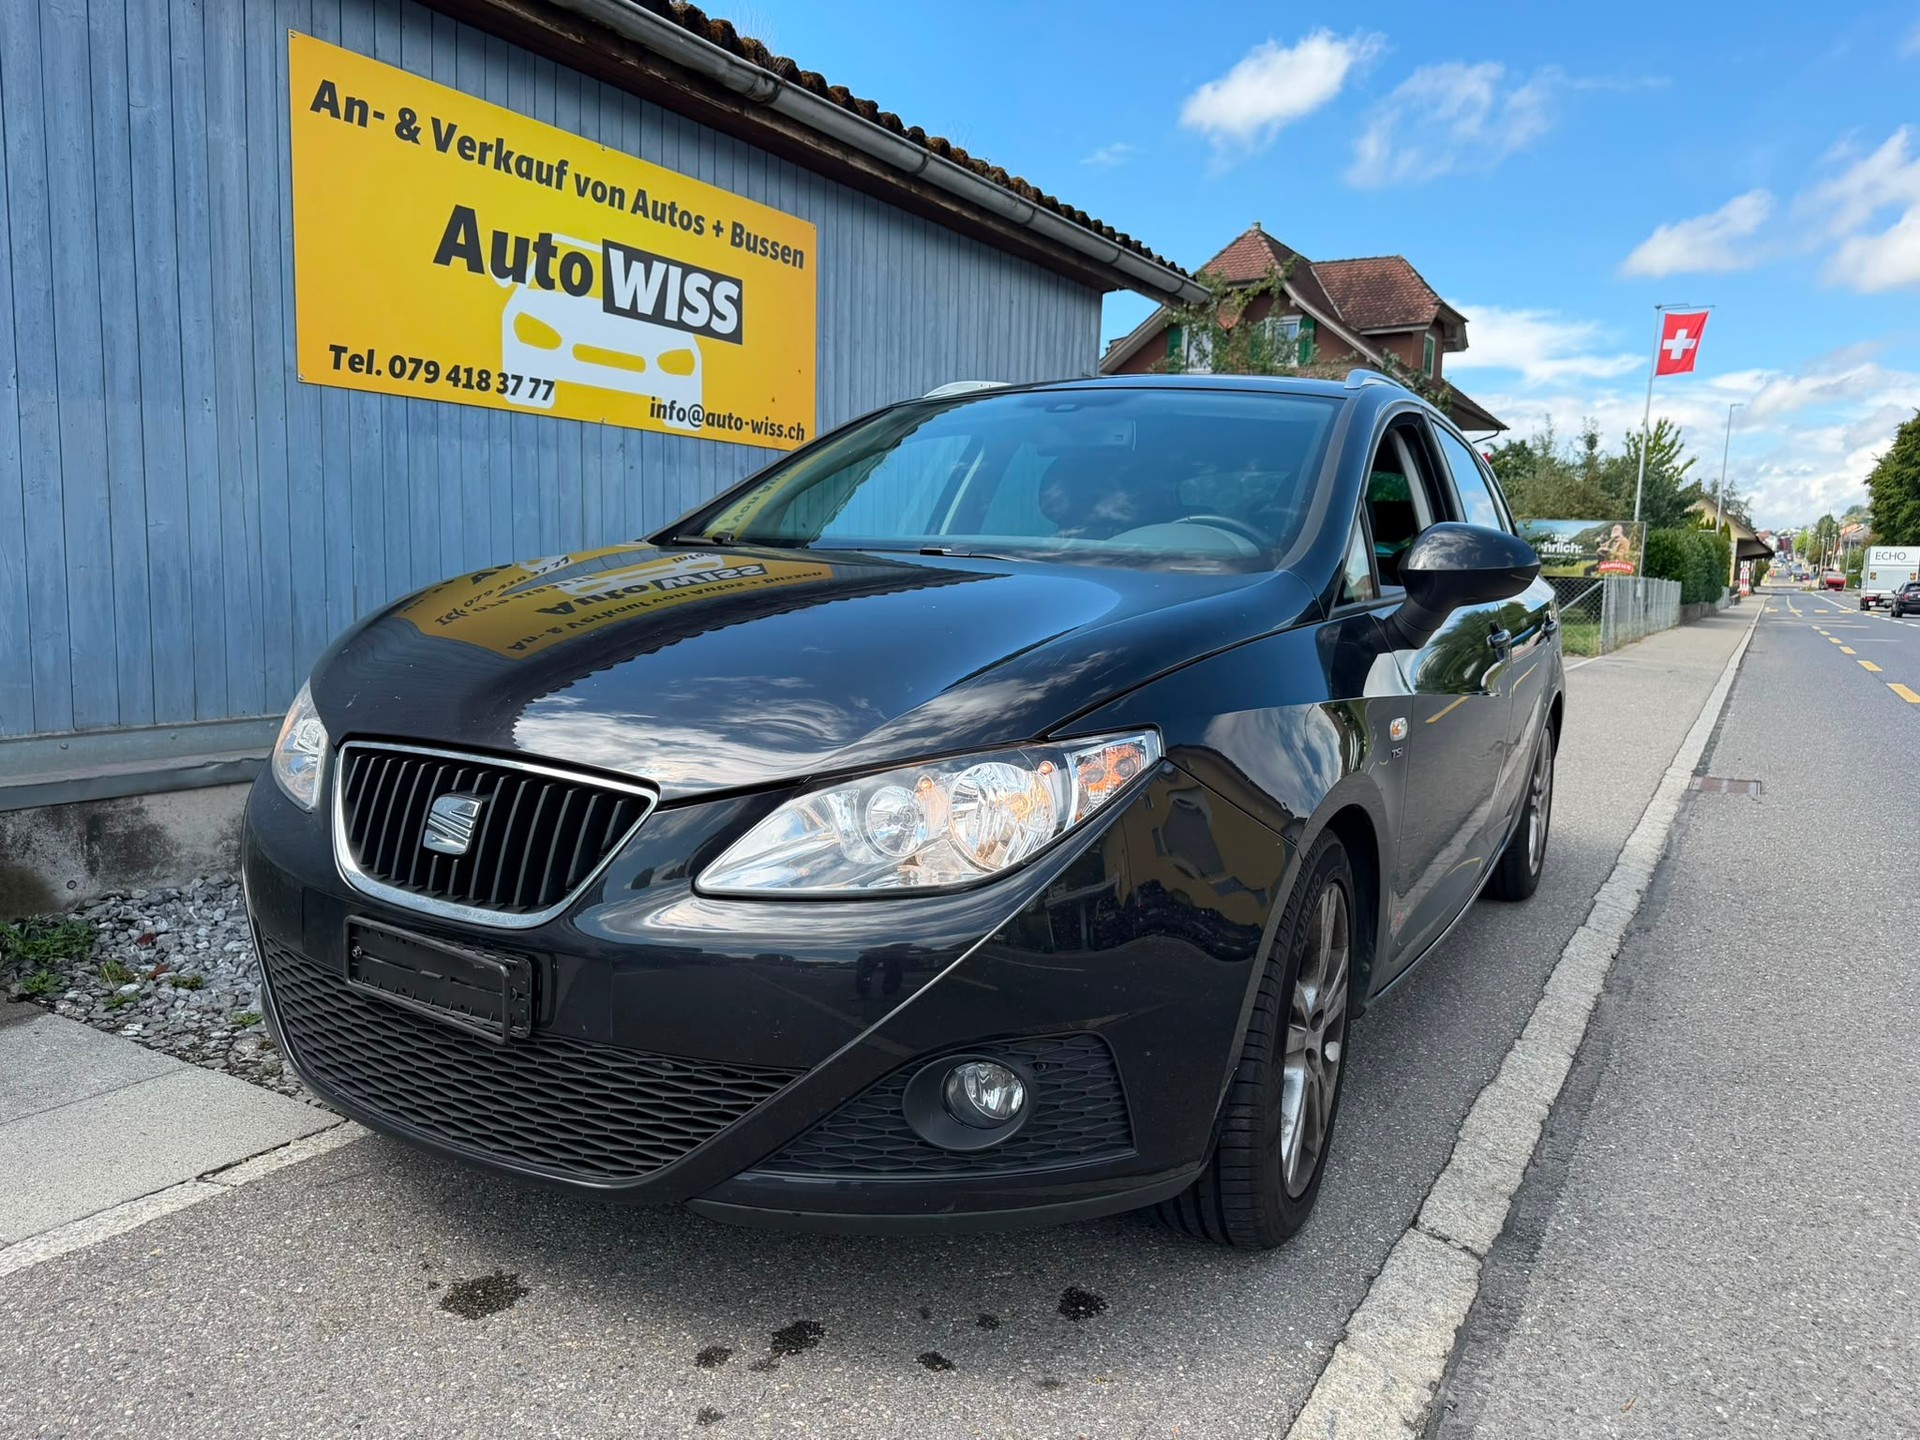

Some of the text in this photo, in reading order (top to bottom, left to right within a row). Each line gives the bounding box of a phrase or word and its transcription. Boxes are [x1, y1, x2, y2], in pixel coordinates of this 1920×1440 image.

[310, 79, 804, 269] An- & Verkauf von Autos + Bussen
[432, 204, 739, 334] Auto WISS
[329, 344, 555, 401] Tel. 079 418 37 77
[650, 396, 805, 441] info@auto-wiss.ch
[1875, 551, 1907, 561] ECHO
